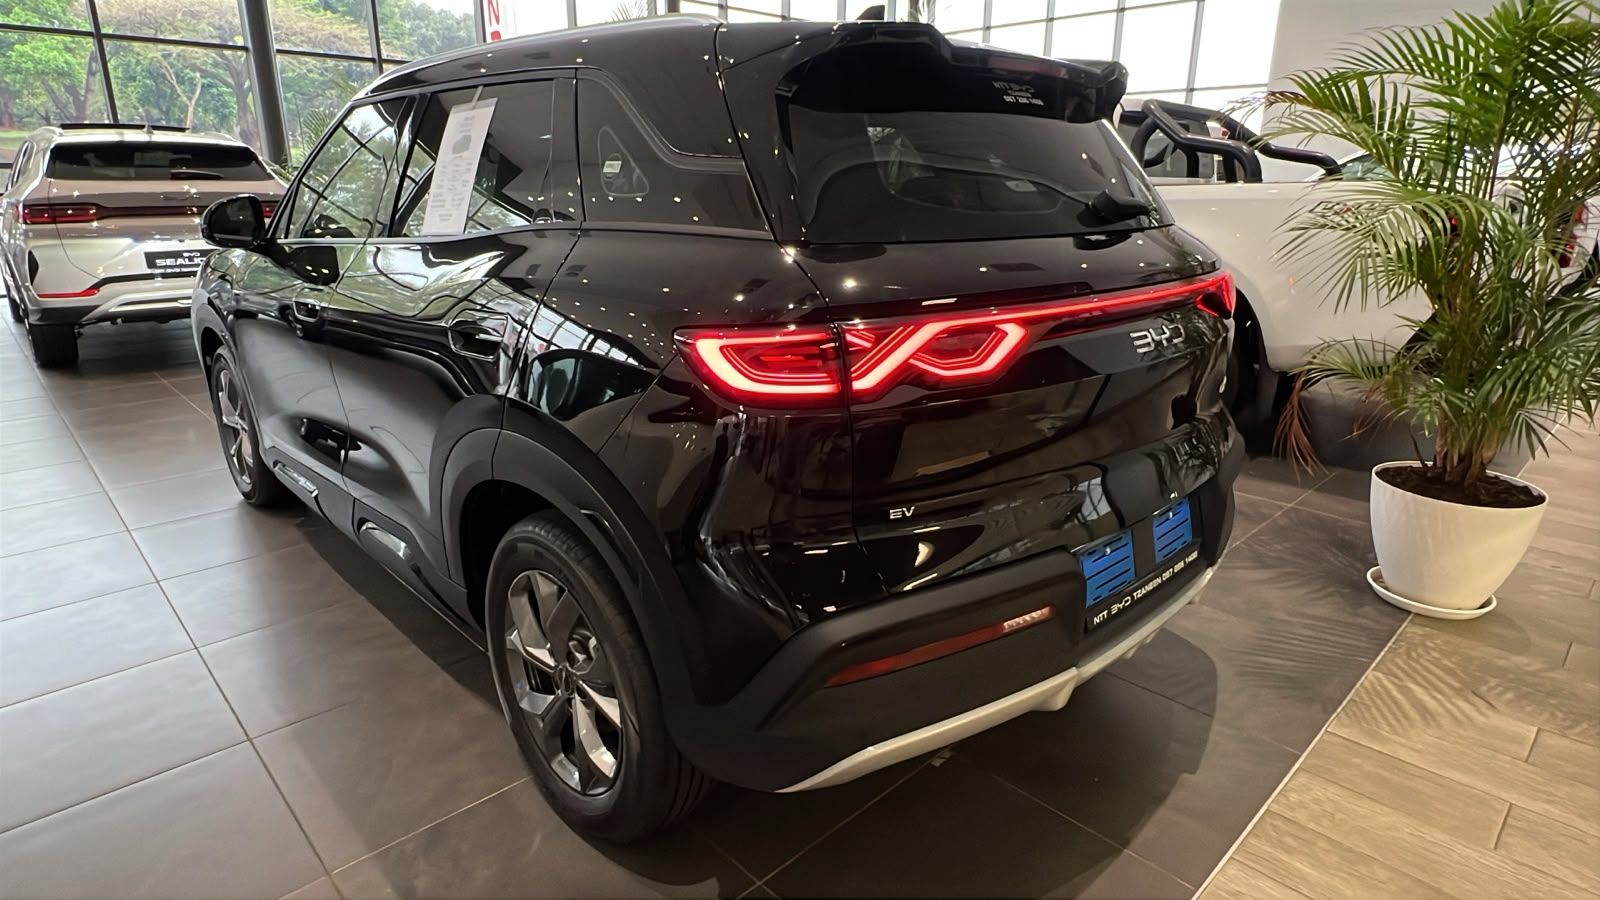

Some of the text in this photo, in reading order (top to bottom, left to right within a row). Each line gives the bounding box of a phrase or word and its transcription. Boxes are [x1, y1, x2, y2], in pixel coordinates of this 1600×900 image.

[1130, 324, 1186, 354] BYD
[889, 506, 916, 520] EV
[1093, 610, 1109, 625] NTT
[1110, 596, 1131, 615] BYD
